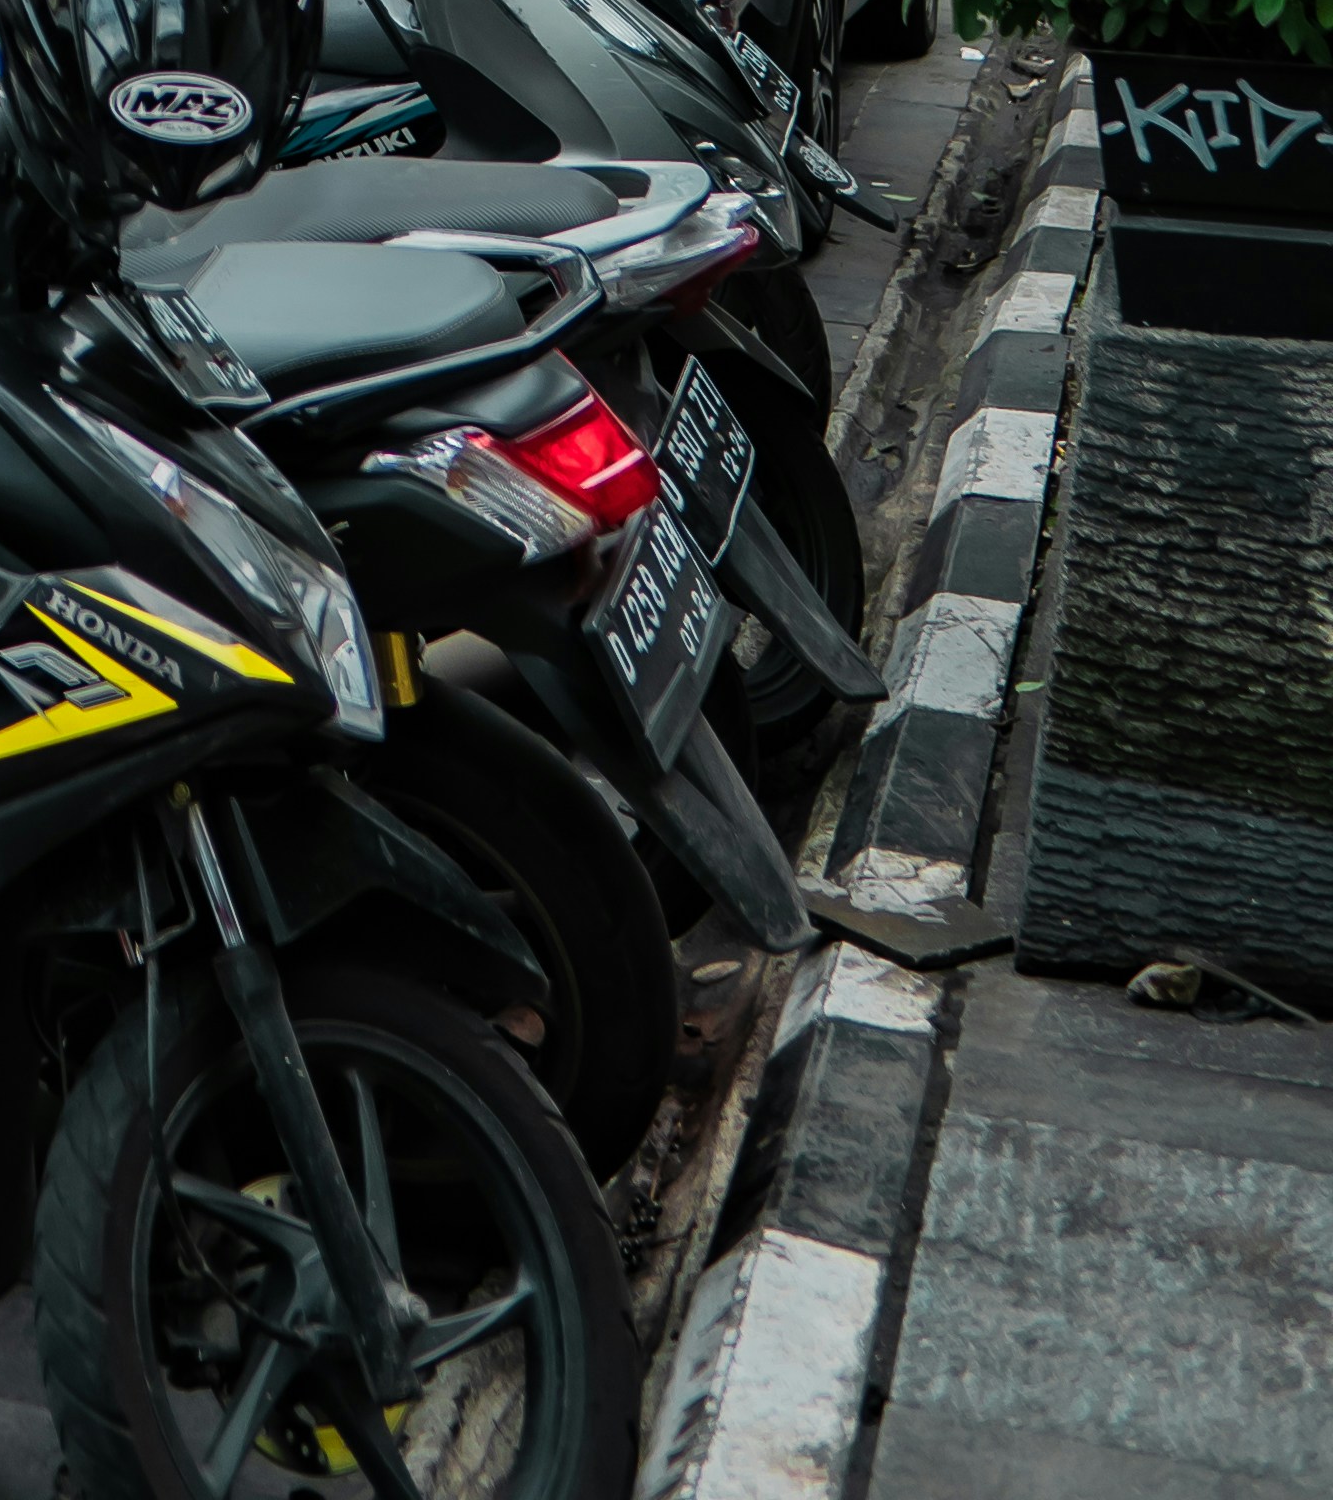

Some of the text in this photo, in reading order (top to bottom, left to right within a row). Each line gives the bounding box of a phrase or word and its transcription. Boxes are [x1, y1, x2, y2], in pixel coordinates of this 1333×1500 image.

[668, 407, 709, 483] 5507
[44, 587, 185, 690] HONDA
[620, 563, 667, 655] 4258
[605, 631, 637, 687] D
